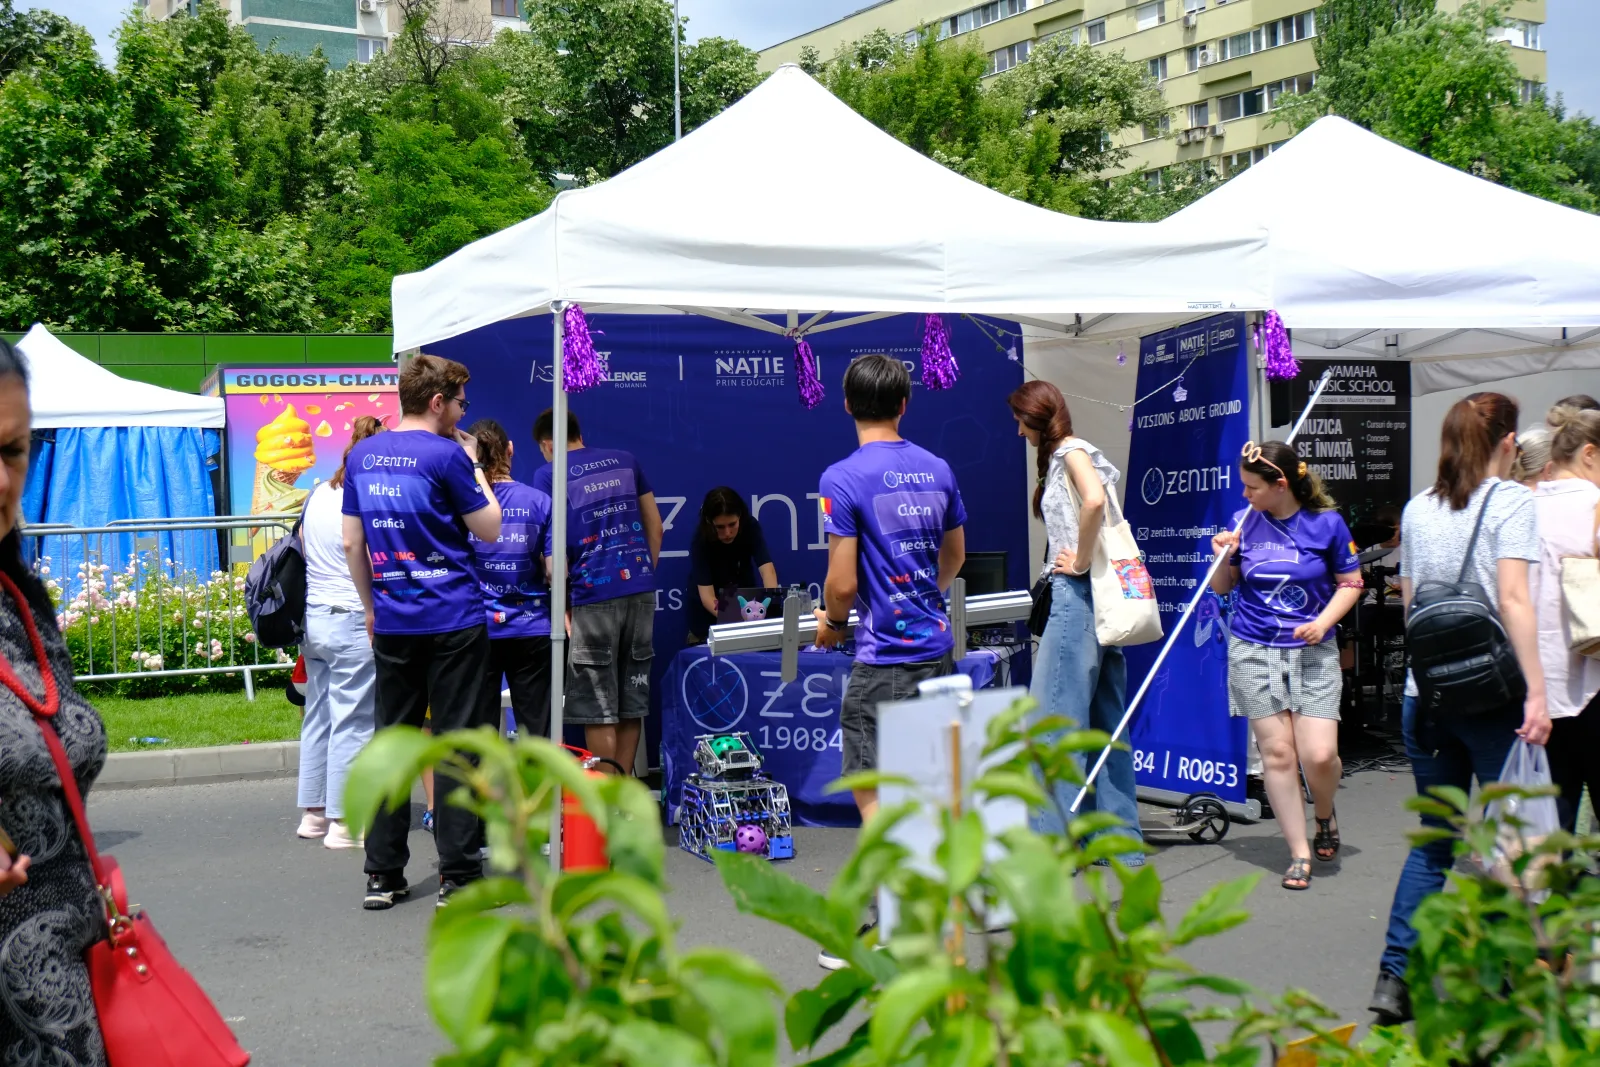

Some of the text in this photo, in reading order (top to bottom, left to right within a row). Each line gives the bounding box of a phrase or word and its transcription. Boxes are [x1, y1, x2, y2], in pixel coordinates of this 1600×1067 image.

[1329, 365, 1378, 378] YAMAHA
[716, 379, 737, 387] PRIN
[1348, 380, 1396, 393] SCHOOL
[1137, 399, 1242, 428] VISIONS ABOVE GROUND
[1298, 418, 1343, 435] MUZICA
[1298, 441, 1312, 458] SE
[375, 456, 417, 468] ZENITH
[583, 458, 620, 471] ZENITH
[1166, 465, 1230, 495] ZENITH
[368, 483, 402, 497] Mihai
[502, 508, 530, 517] NITH
[372, 518, 406, 529] Grafică
[600, 527, 618, 537] ING
[484, 561, 517, 571] Grafică
[914, 567, 931, 580] ING
[758, 725, 844, 752] 19084
